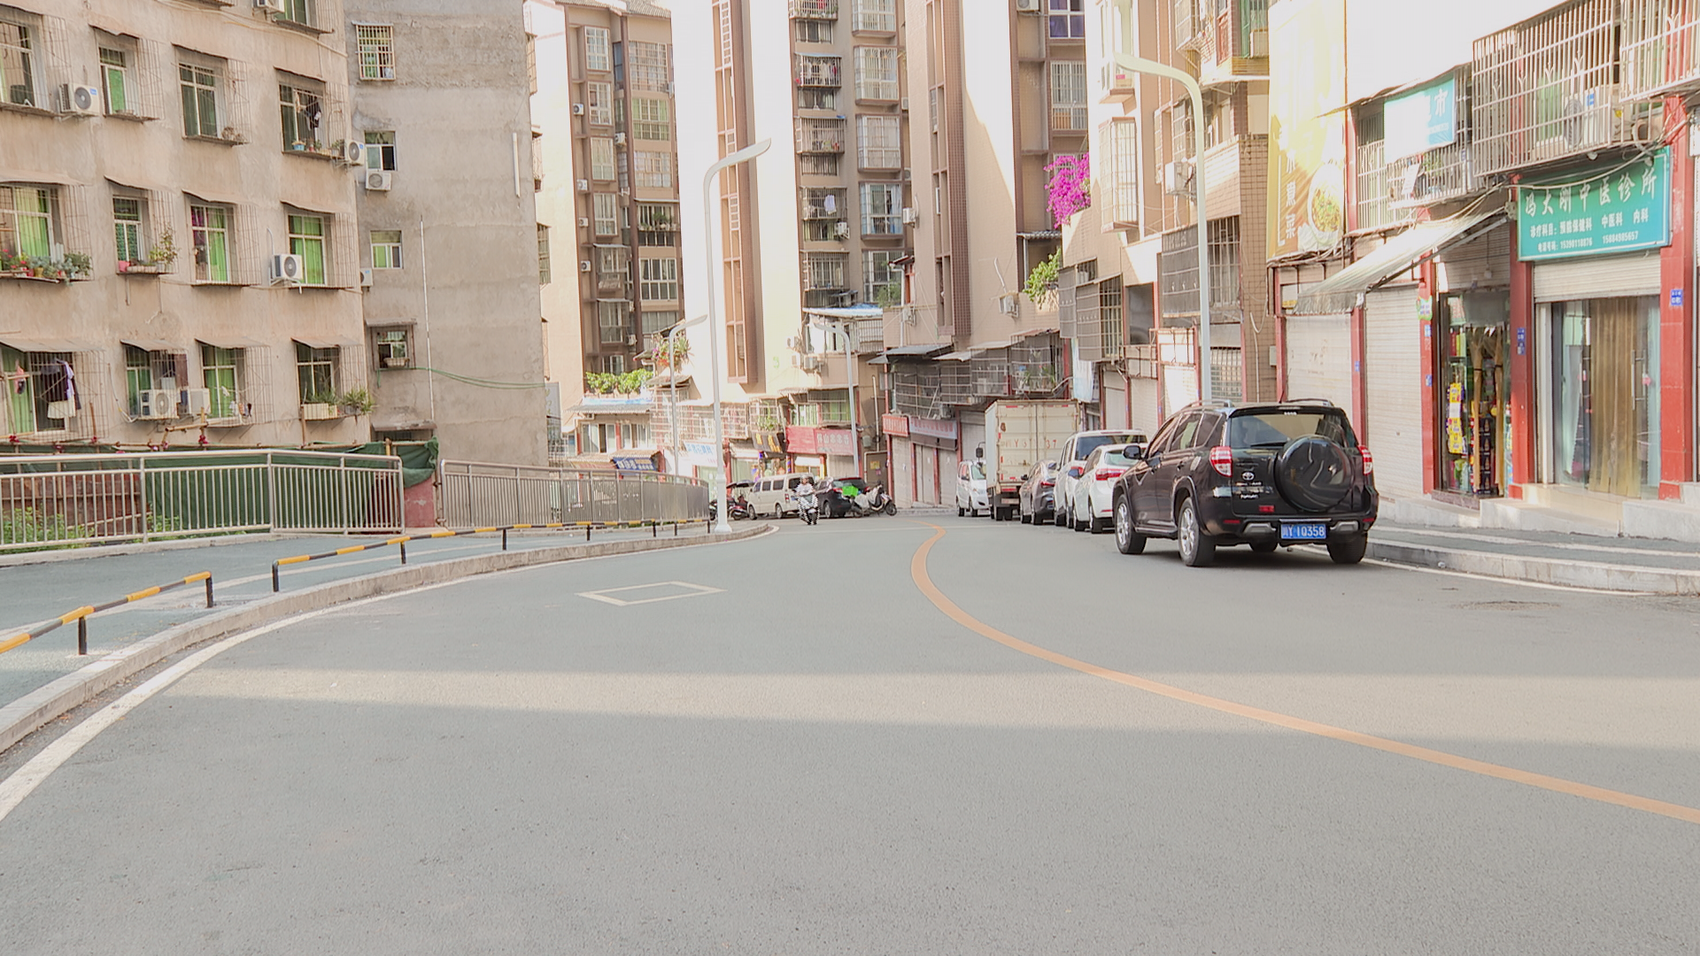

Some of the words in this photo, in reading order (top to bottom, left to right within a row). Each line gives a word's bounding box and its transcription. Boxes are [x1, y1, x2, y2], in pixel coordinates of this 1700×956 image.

[1602, 212, 1623, 229] 中医科
[1633, 208, 1649, 225] 内科
